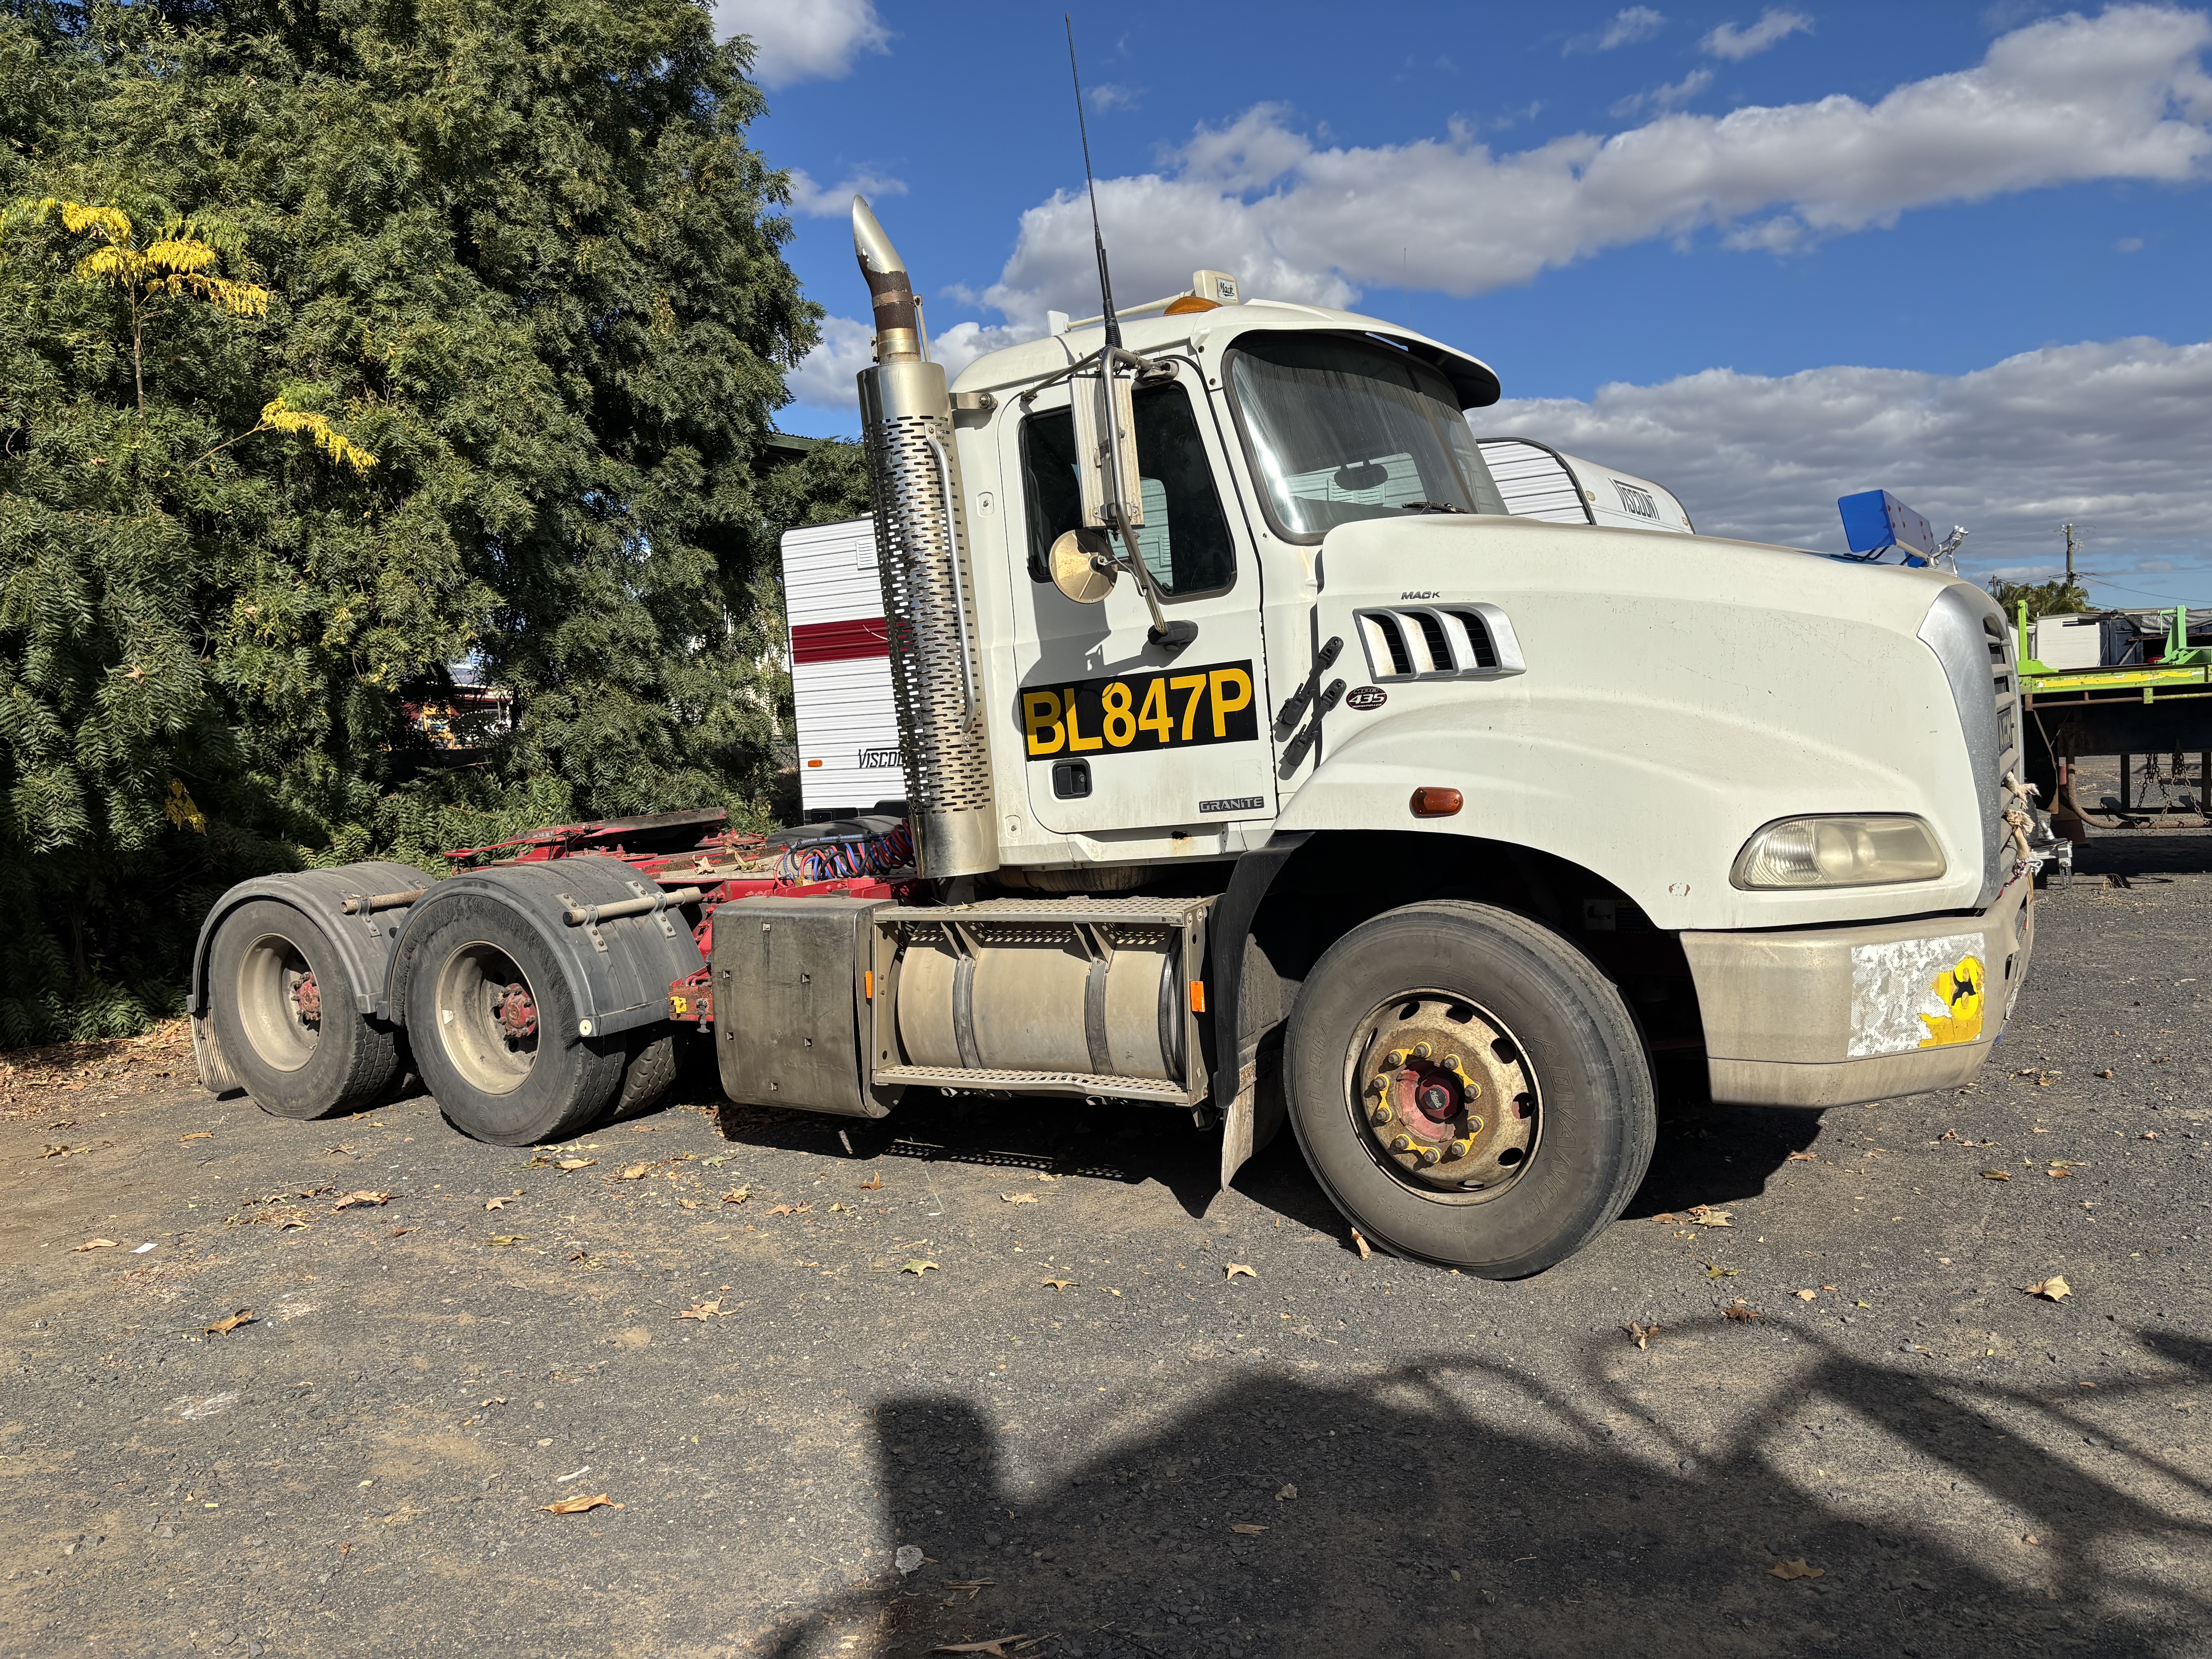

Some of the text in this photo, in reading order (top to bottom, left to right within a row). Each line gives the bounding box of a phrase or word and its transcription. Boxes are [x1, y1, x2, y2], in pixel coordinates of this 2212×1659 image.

[1219, 282, 1235, 296] Mack
[1607, 477, 1660, 520] VISCOUNT
[1401, 591, 1440, 600] MACK
[1348, 693, 1386, 704] 435
[1023, 668, 1252, 756] BL847P
[1200, 798, 1262, 811] GRANITE
[1429, 1090, 1443, 1108] Mack
